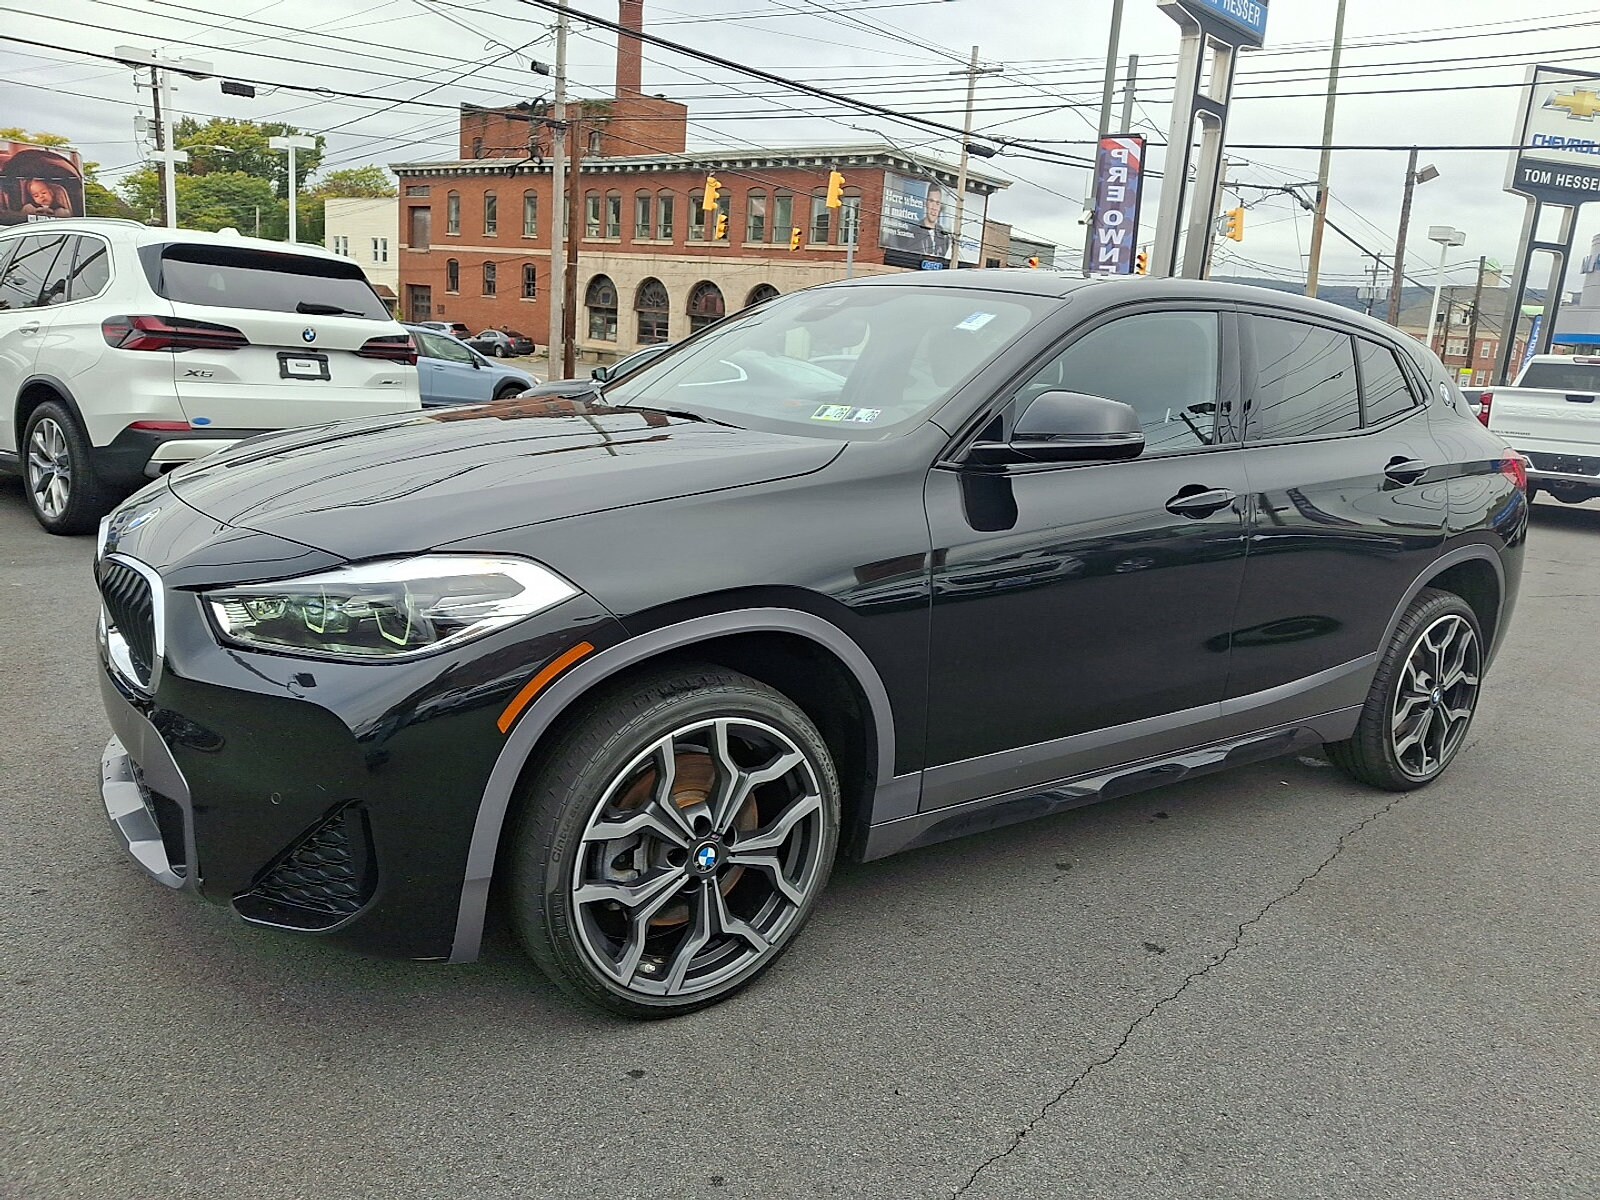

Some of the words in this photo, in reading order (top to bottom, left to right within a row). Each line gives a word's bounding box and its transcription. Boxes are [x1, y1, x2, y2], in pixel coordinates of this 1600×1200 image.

[1532, 133, 1600, 155] CHEVROL
[1524, 169, 1552, 184] TOM
[1555, 173, 1600, 192] HESSE
[885, 189, 903, 204] Here
[903, 195, 924, 208] when
[184, 368, 214, 378] X5
